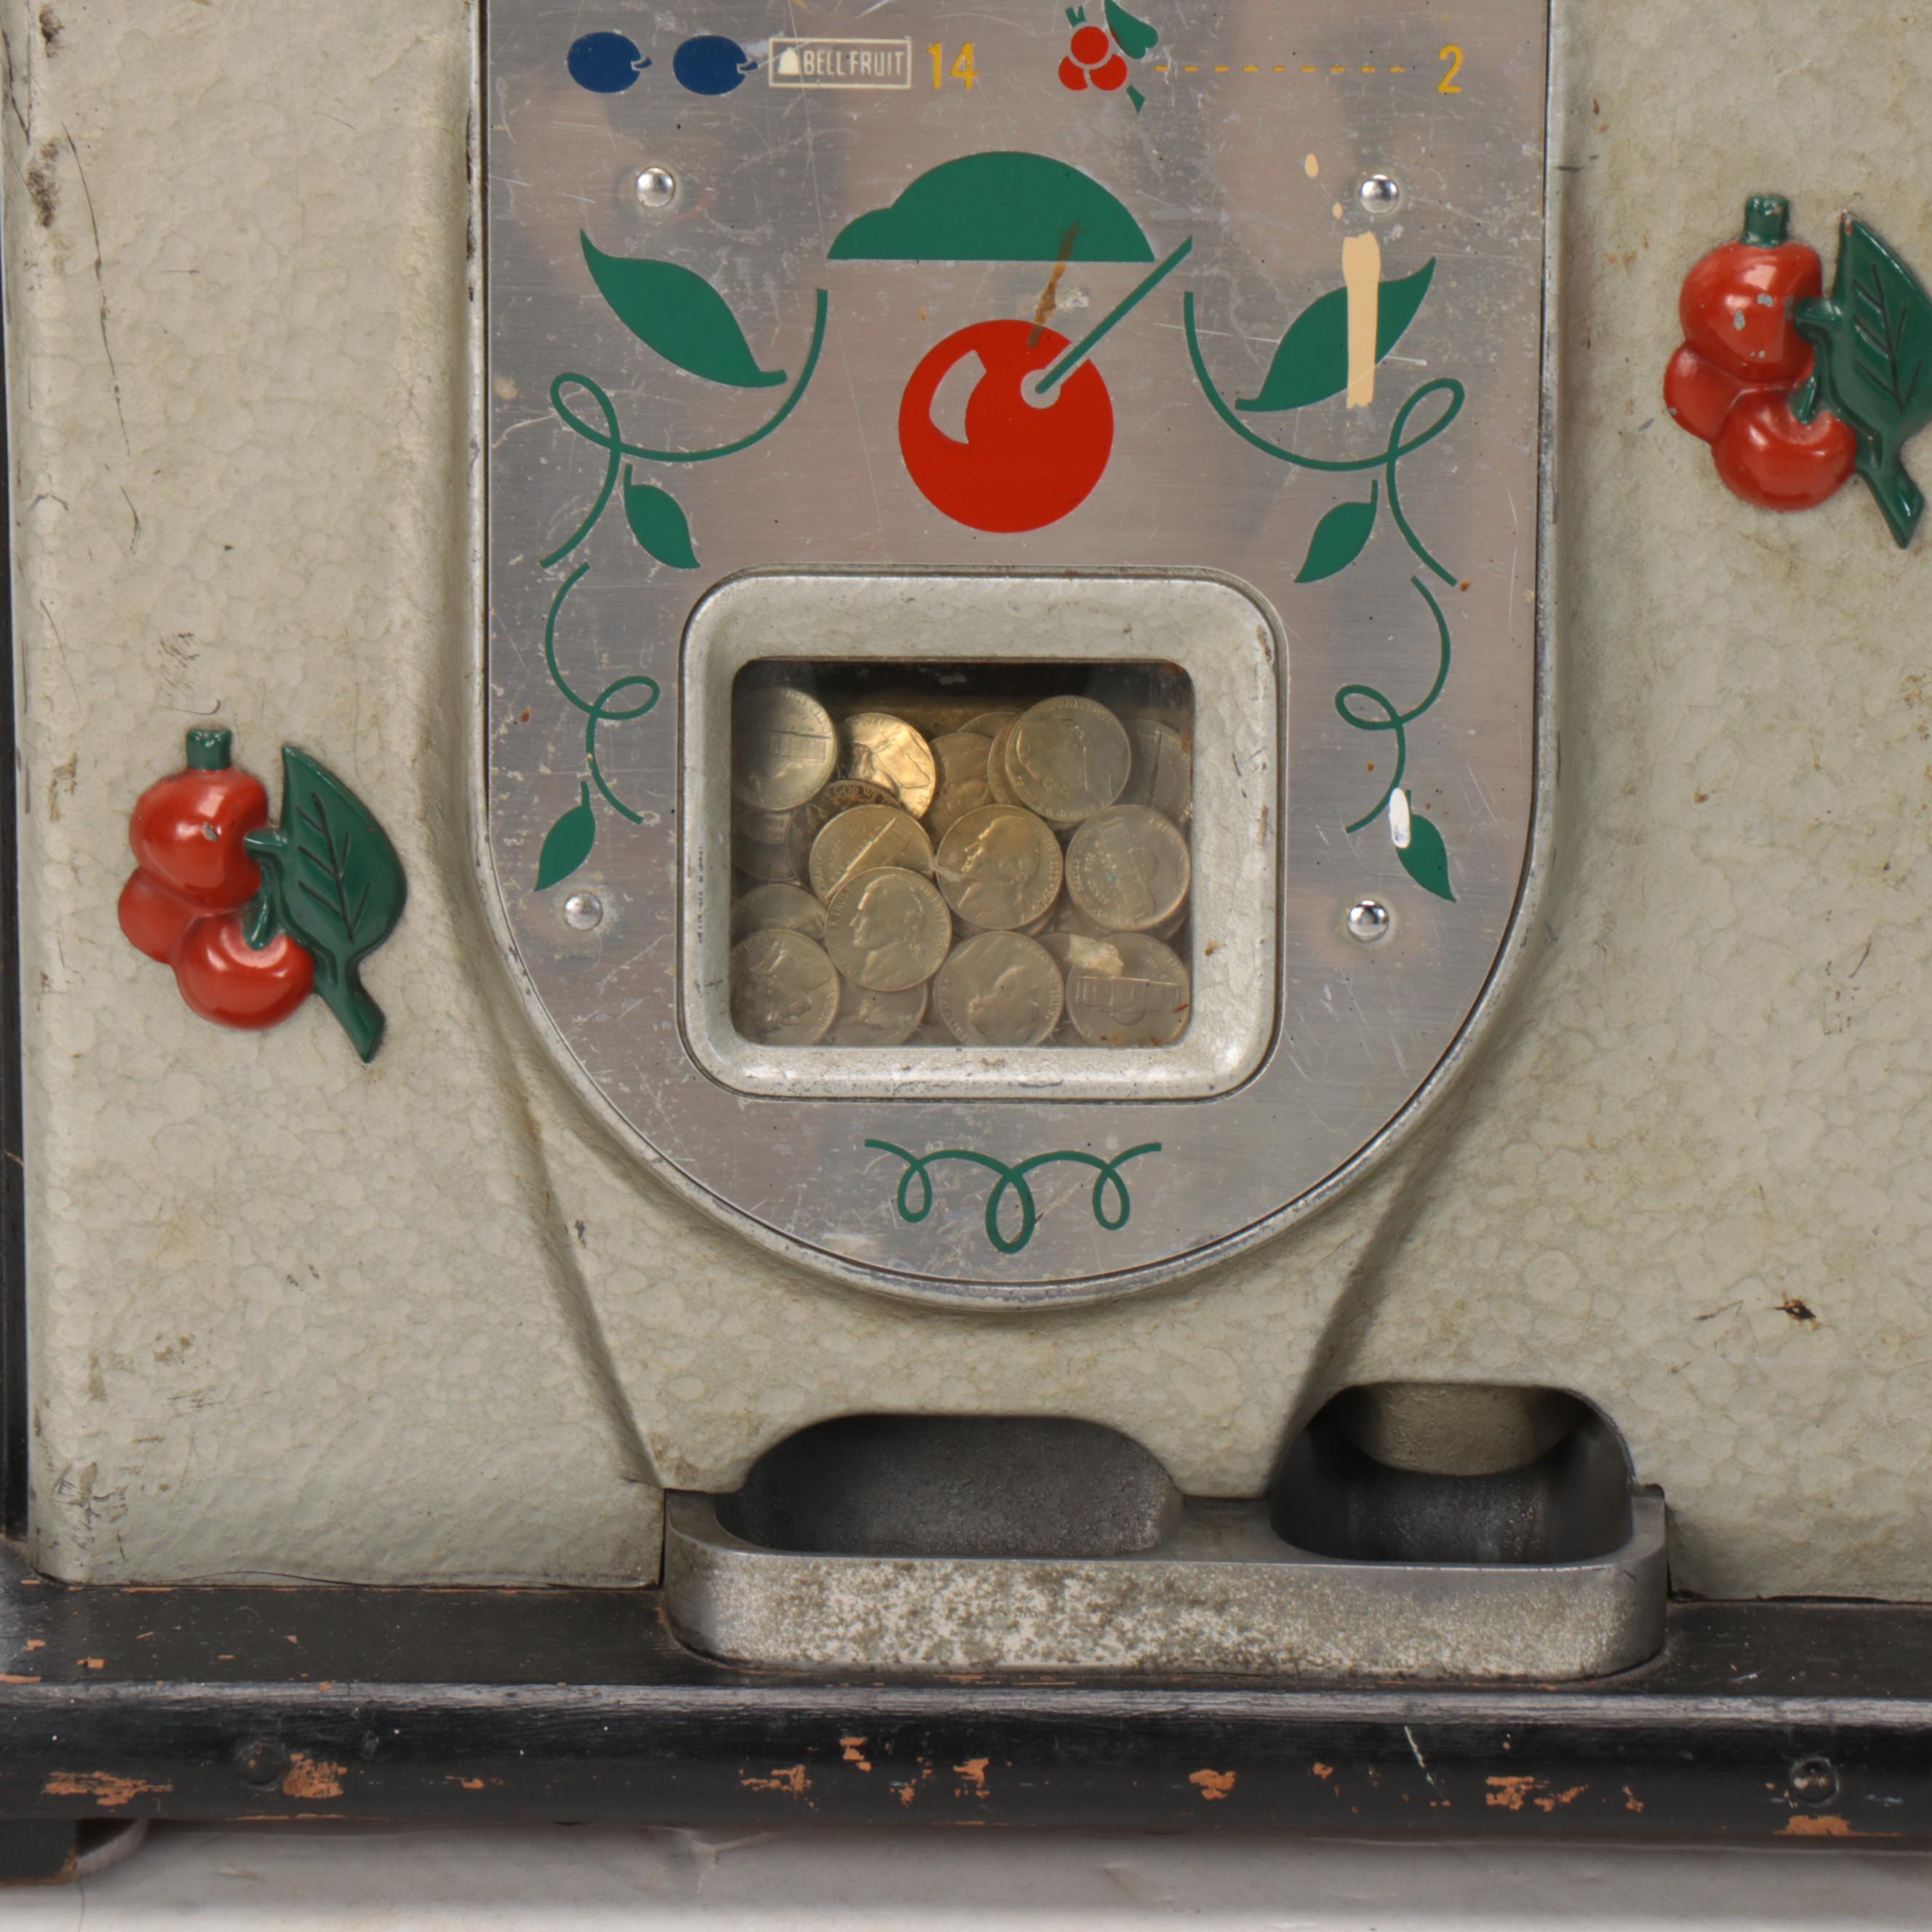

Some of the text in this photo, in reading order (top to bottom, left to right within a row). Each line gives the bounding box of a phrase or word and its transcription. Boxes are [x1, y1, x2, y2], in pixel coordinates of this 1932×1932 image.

[802, 41, 978, 89] BELL FRUIT 14
[1437, 45, 1464, 93] 2
